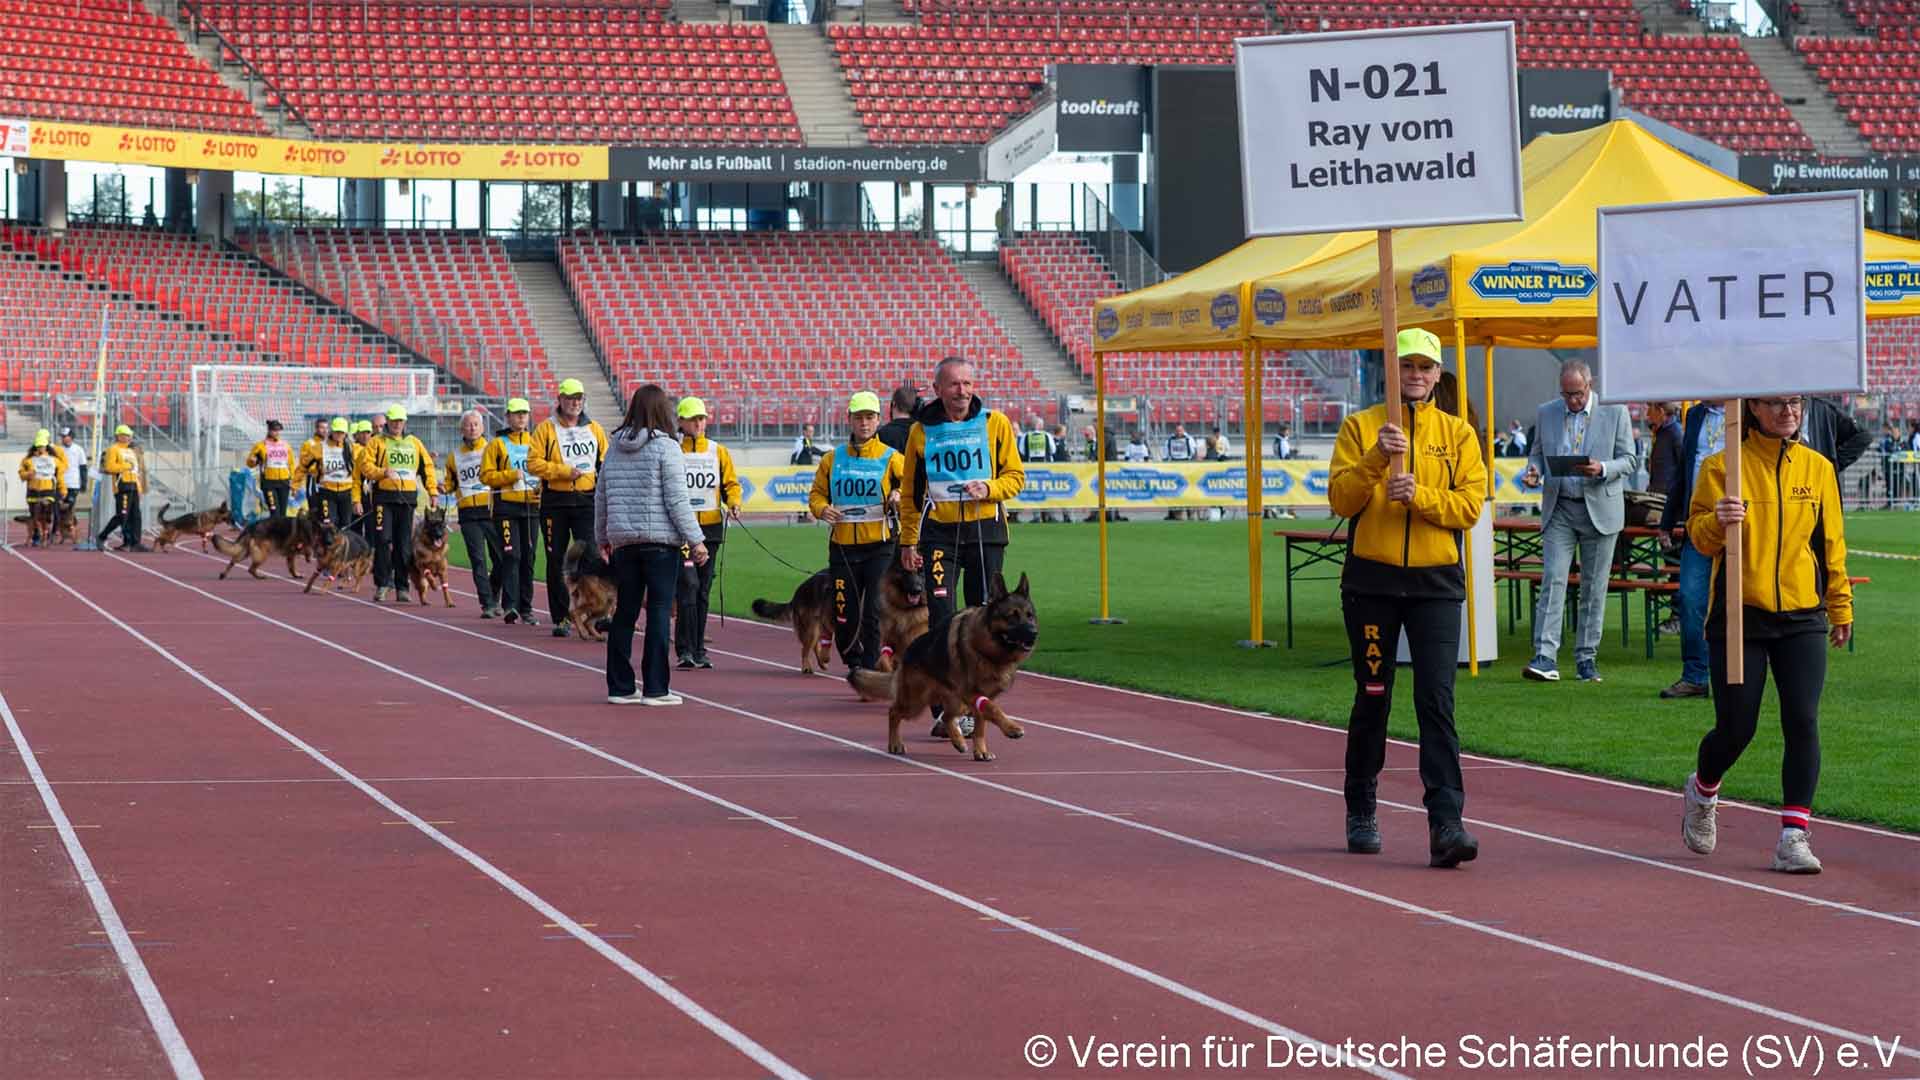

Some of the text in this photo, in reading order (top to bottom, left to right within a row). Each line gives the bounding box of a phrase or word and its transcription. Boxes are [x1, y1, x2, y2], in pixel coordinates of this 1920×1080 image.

[1309, 61, 1448, 103] N-021
[1060, 100, 1140, 115] toolcraft
[1529, 103, 1606, 120] toolcraft
[49, 129, 91, 147] LOTTO
[1308, 117, 1454, 150] Ray vom
[136, 134, 177, 153] LOTTO
[218, 142, 258, 159] LOTTO
[300, 146, 346, 165] LOTTO
[405, 150, 462, 166] LOTTO
[524, 151, 581, 167] LOTTO
[648, 156, 948, 173] Mehr als Fußball stadion-nuernberg.de
[1290, 151, 1477, 189] Leithawald
[1774, 164, 1798, 179] Die
[1800, 164, 1889, 180] Eventlocation
[1482, 274, 1585, 289] WINNER PLUS
[1865, 272, 1920, 287] NER PLU
[1612, 271, 1836, 326] VATER
[562, 440, 595, 457] 7001
[325, 460, 345, 471] 705
[389, 453, 416, 465] 5001
[930, 447, 983, 473] 1001
[459, 464, 481, 482] 302
[686, 473, 716, 489] 002
[775, 482, 813, 494] WINN
[834, 478, 878, 497] 1002
[1042, 480, 1070, 491] PLUS
[1150, 478, 1177, 490] PLUS
[1207, 476, 1284, 490] WINNE LUS
[1791, 486, 1812, 496] RAY
[931, 549, 945, 585] RAY
[834, 579, 846, 614] RAY
[1363, 624, 1382, 676] RAY
